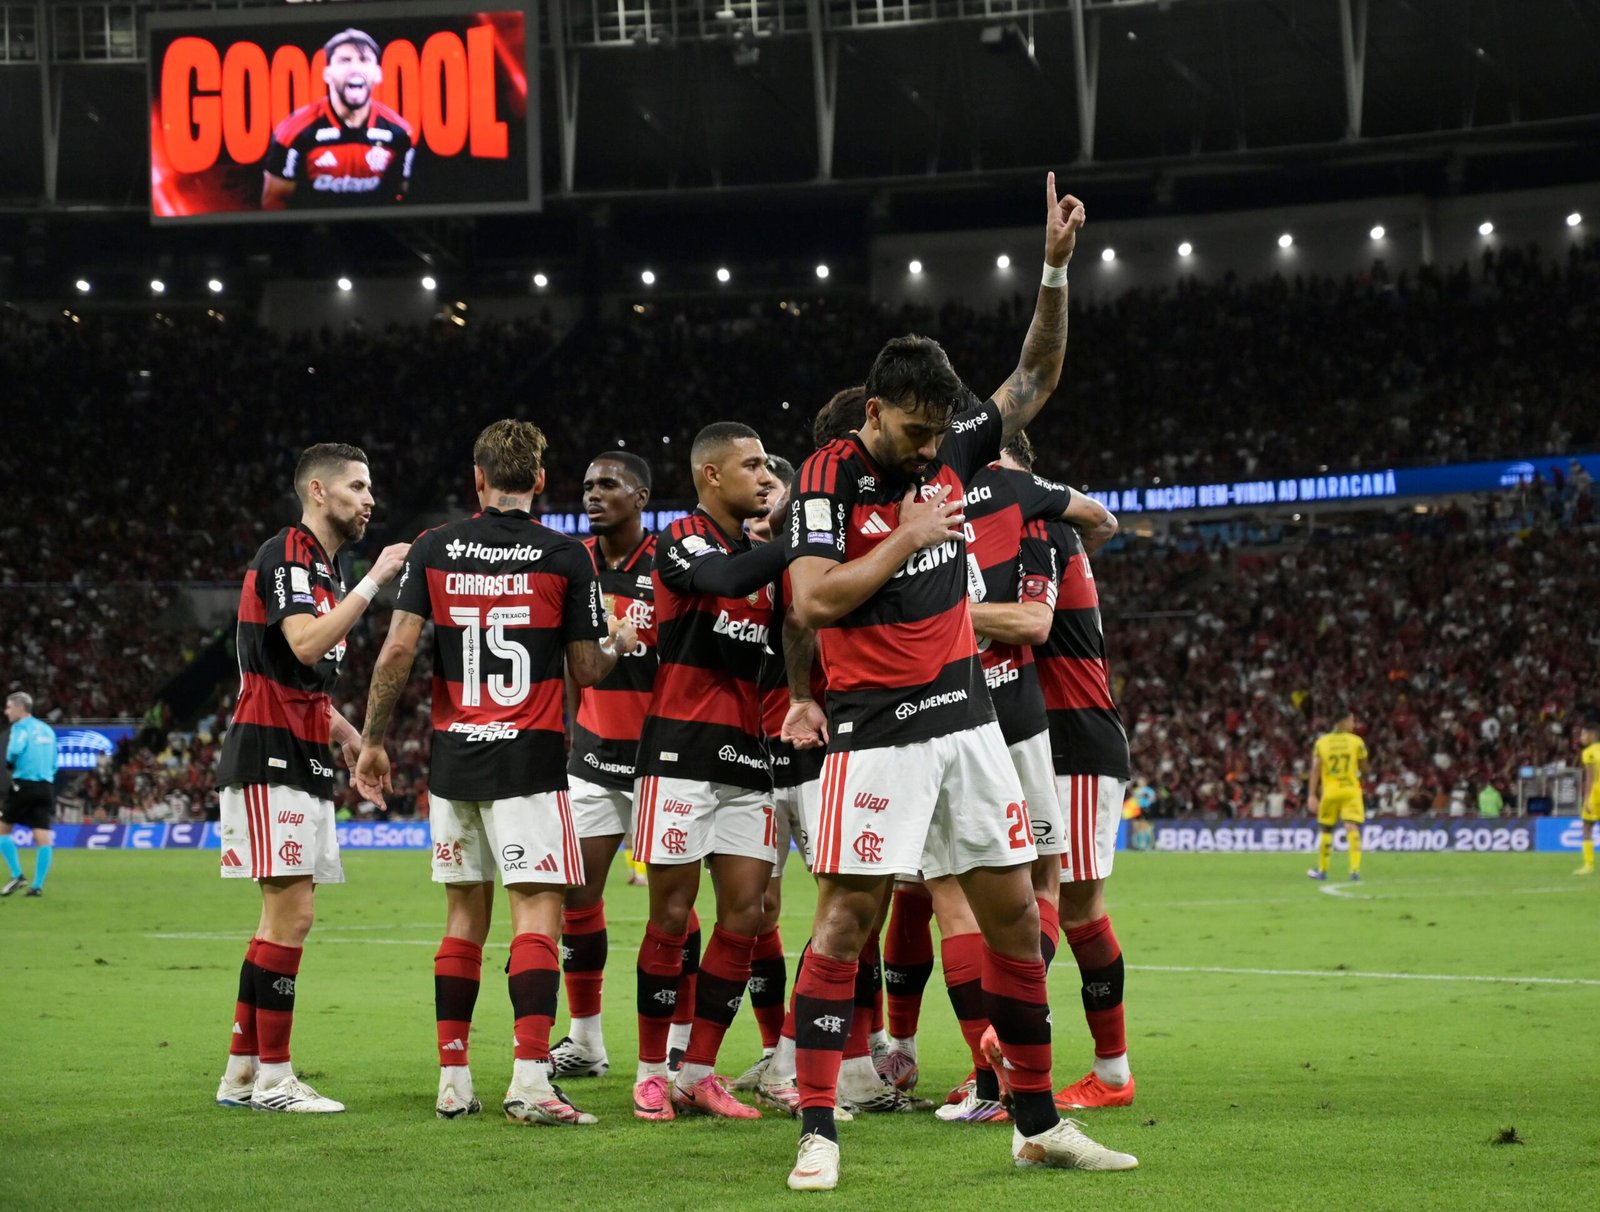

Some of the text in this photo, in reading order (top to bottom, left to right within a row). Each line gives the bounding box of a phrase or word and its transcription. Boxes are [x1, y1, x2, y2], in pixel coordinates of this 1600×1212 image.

[1278, 479, 1298, 502] AO
[1300, 469, 1397, 500] MARACANÃ
[790, 500, 801, 548] Shopee
[465, 542, 542, 564] Hapvida
[274, 566, 286, 610] Shopee
[446, 573, 533, 596] CARRASCAL
[588, 581, 599, 627] Shopee
[501, 612, 527, 620] TEXACO
[449, 606, 531, 707] 15
[918, 689, 968, 711] ADEMICON
[1329, 754, 1352, 774] 27
[662, 799, 693, 817] Wap
[854, 792, 890, 813] Wap
[278, 810, 304, 827] Wap
[373, 824, 426, 847] Sorte
[1036, 836, 1056, 845] AC
[1362, 824, 1449, 851] Betano
[1455, 828, 1530, 851] 2026
[504, 861, 528, 871] GAC
